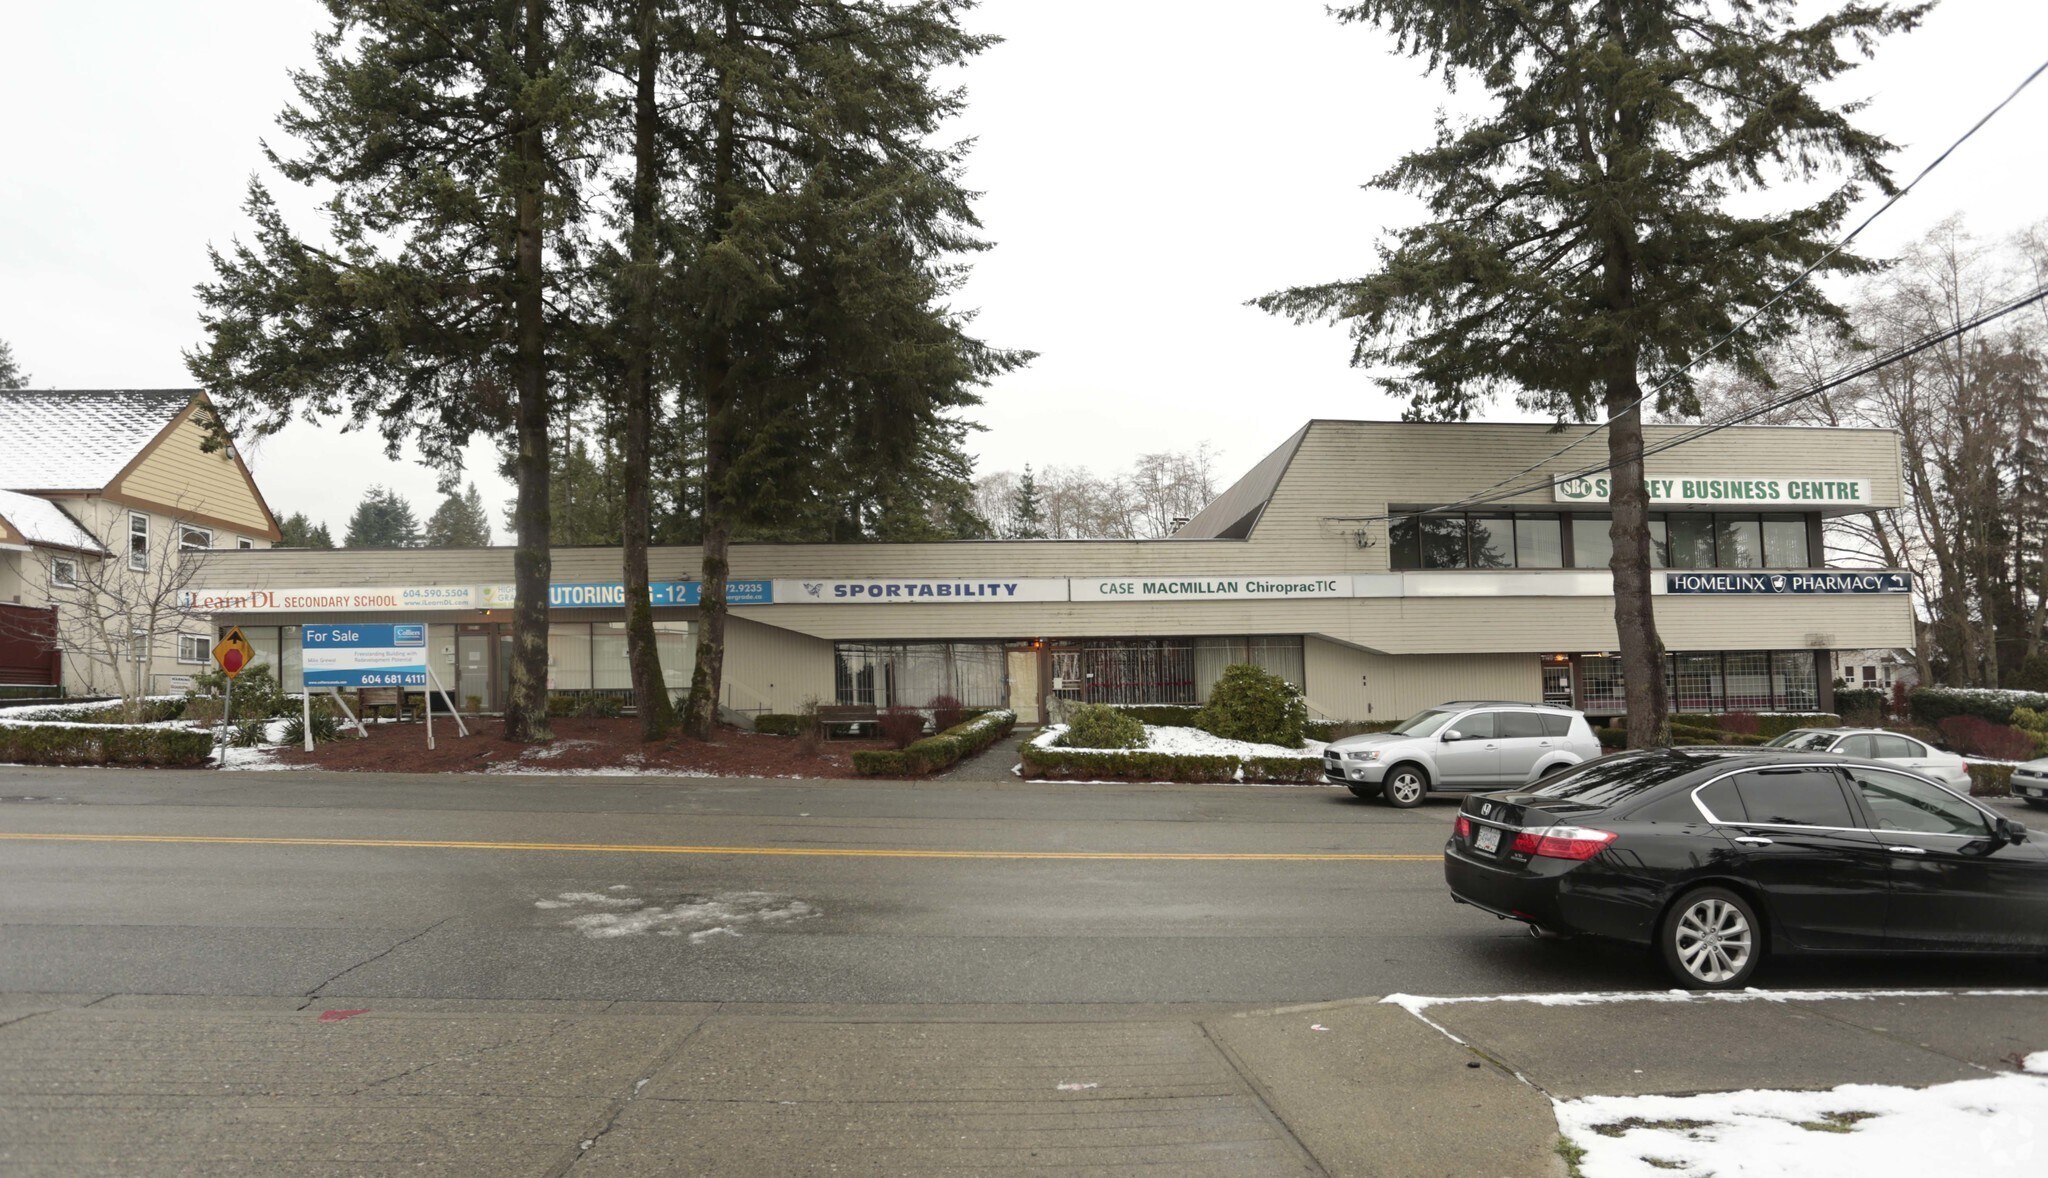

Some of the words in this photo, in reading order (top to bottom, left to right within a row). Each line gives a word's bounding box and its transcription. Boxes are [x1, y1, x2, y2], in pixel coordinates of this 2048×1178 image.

[1562, 479, 1591, 496] SBC
[1682, 480, 1781, 499] BUSINESS
[1788, 481, 1860, 500] CENTRE
[1099, 582, 1135, 595] CASE
[1142, 581, 1239, 594] MACMILLAN
[1245, 580, 1337, 595] ChiropracTIC
[1675, 576, 1766, 590] HOMELINX
[1793, 576, 1883, 590] PHARMACY
[403, 589, 469, 598] 604.590.5504
[834, 583, 1018, 598] SPORTABILITY
[284, 596, 351, 608] SECONDARY
[354, 595, 398, 607] SCHOOL
[306, 630, 328, 642] For
[332, 630, 359, 642] Sale
[361, 674, 381, 684] 604
[384, 674, 402, 684] 681
[405, 674, 426, 684] 4111
